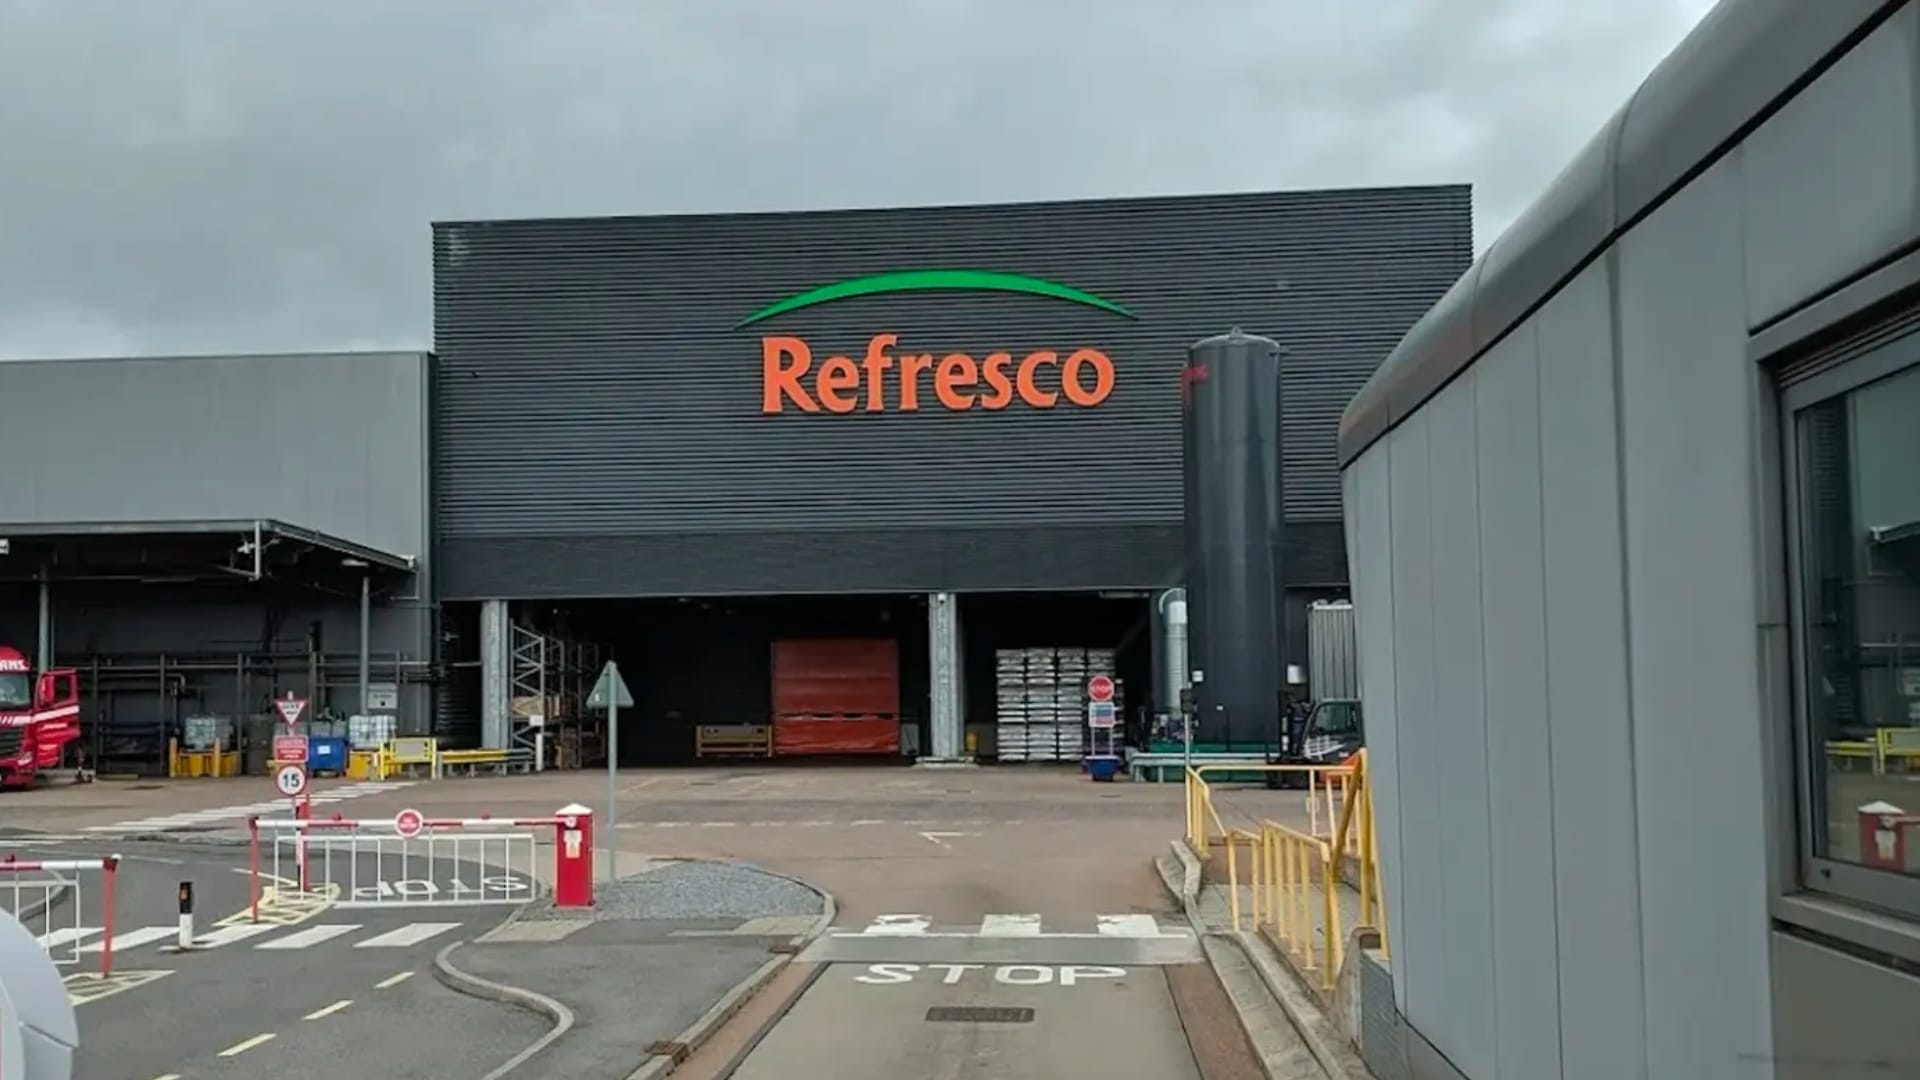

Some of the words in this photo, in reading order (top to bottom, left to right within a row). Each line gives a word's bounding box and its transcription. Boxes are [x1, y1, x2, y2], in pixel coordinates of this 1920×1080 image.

[762, 333, 1115, 413] Refresco
[283, 773, 300, 788] 15
[854, 964, 1127, 985] STOP
